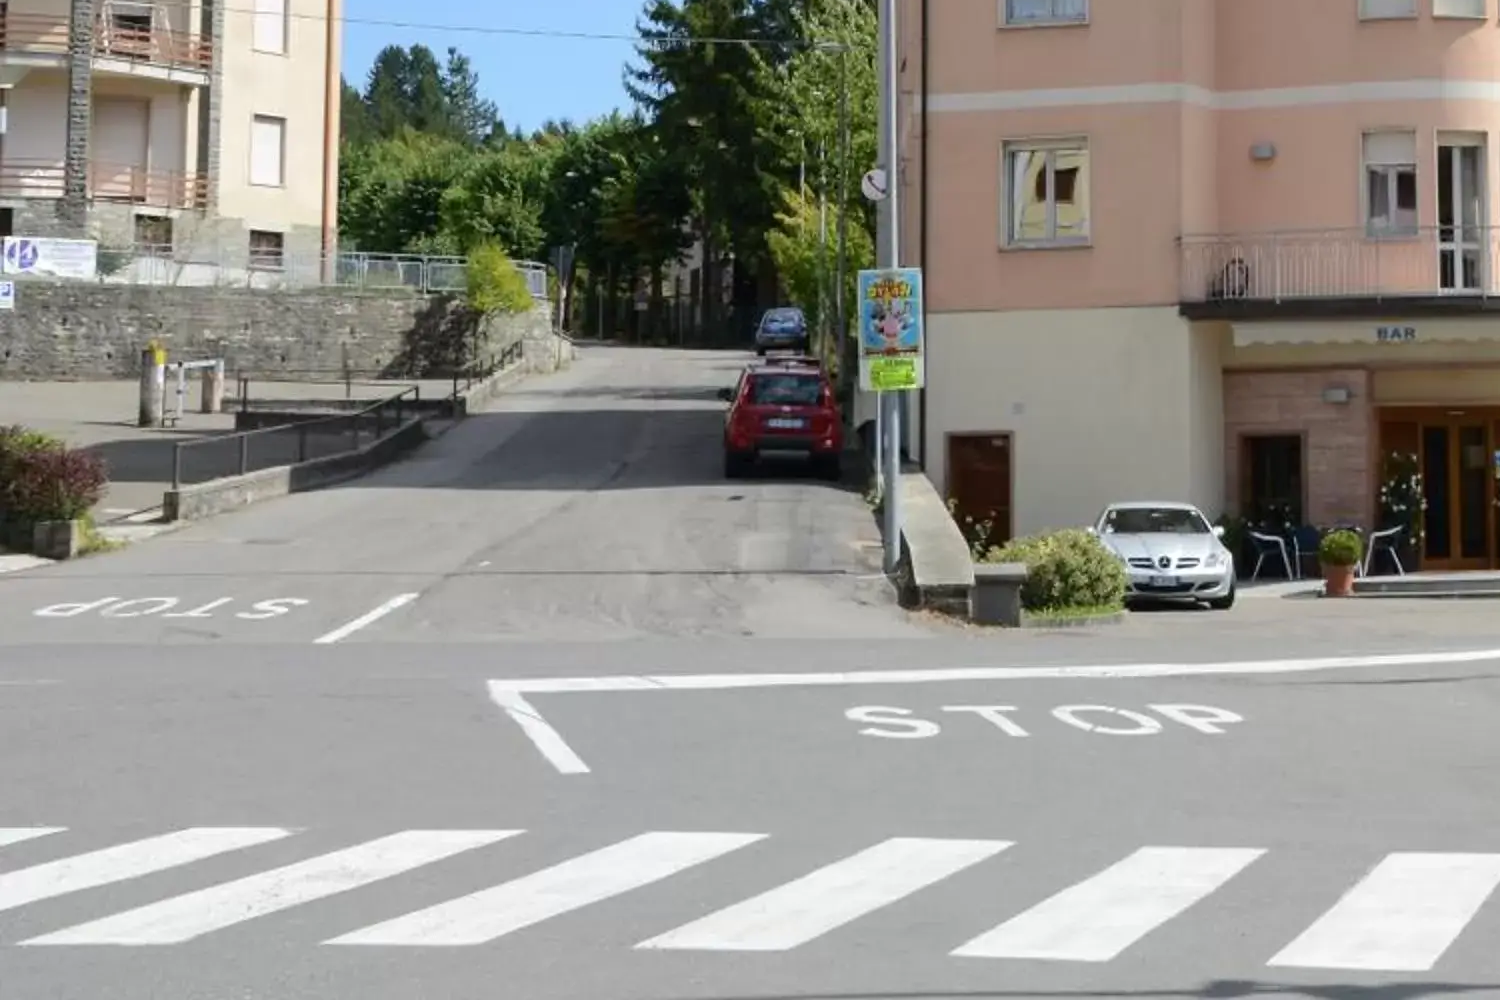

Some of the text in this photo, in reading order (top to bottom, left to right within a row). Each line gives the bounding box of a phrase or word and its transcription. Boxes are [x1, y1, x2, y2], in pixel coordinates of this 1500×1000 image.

[1377, 326, 1416, 340] BAR
[32, 597, 309, 619] STOP
[845, 703, 1245, 739] STOP
